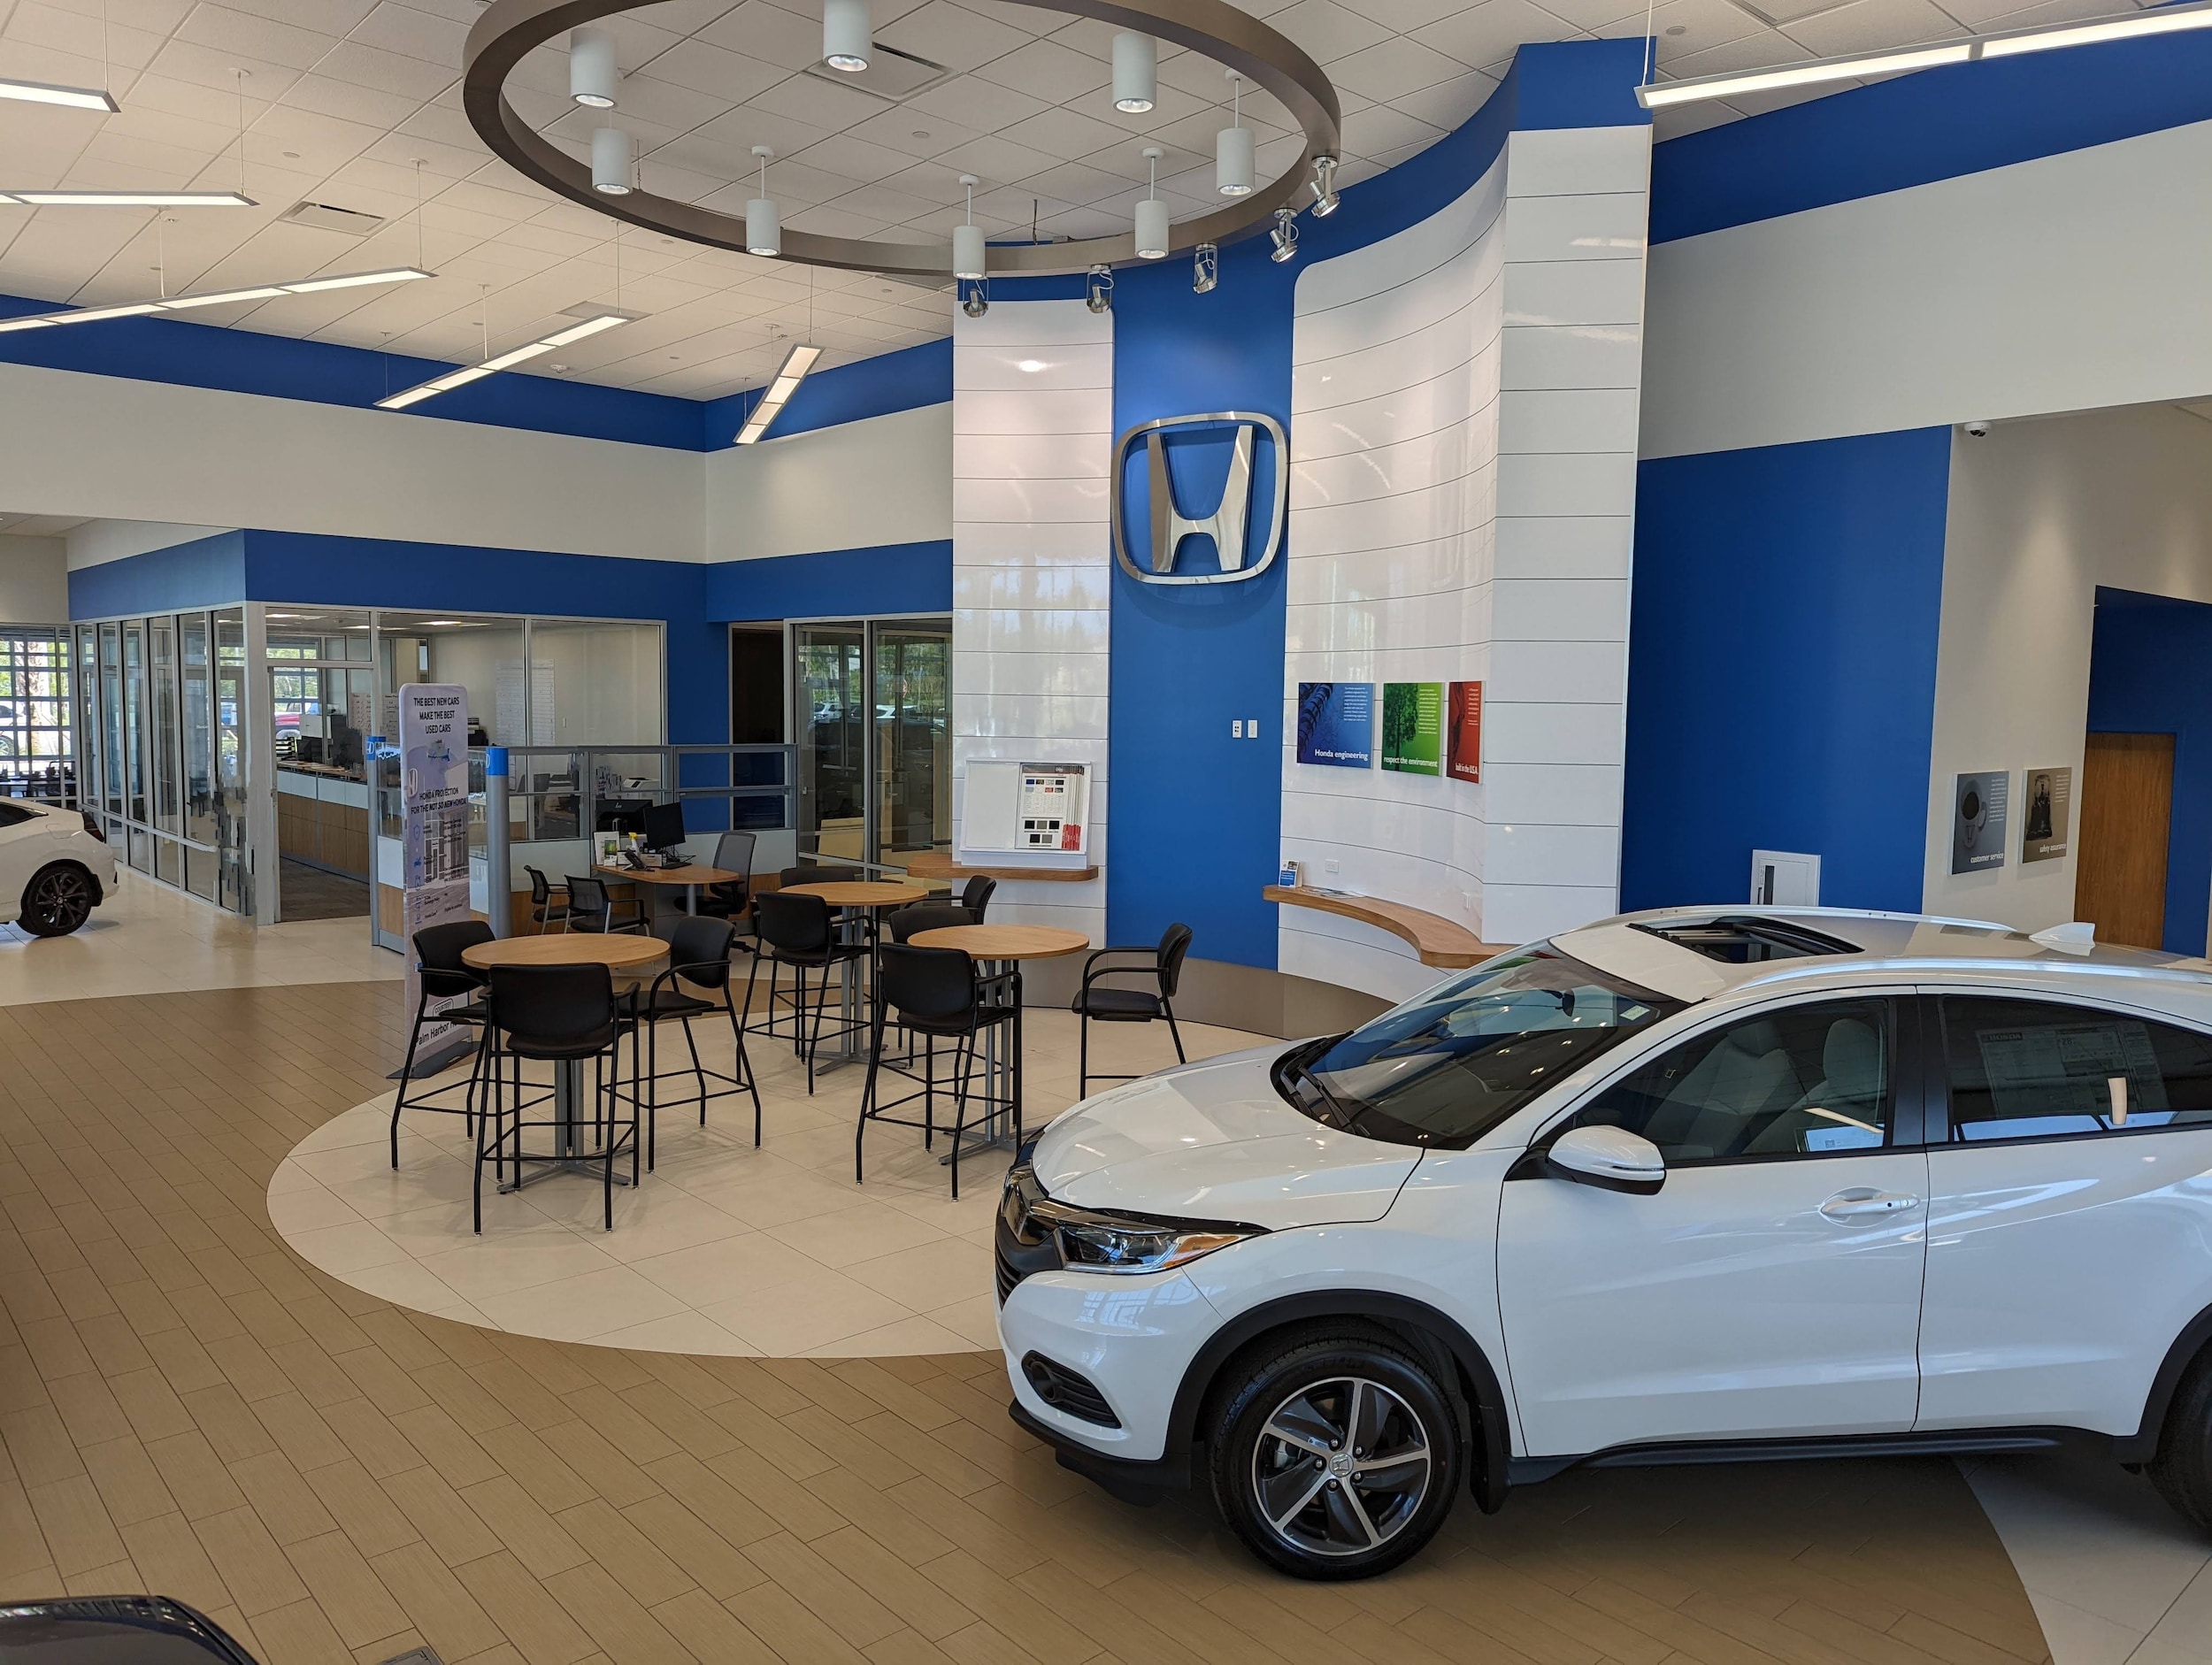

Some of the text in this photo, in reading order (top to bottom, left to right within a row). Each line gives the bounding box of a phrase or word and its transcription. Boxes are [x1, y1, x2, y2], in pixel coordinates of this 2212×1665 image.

[413, 696, 460, 706] THE BEST NEW CARS
[419, 710, 456, 720] MAKE THE BEST
[426, 724, 451, 734] USED CARS
[1314, 748, 1369, 762] Honda engineering
[1384, 756, 1400, 765] respect
[1409, 757, 1438, 768] environment
[411, 805, 420, 814] FOR
[420, 804, 429, 813] THE
[429, 802, 438, 811] NOT
[438, 801, 444, 809] SO
[444, 799, 453, 809] NEW
[2039, 844, 2050, 854] safety
[1970, 850, 2004, 863] customer service
[430, 1022, 449, 1040] Harbor
